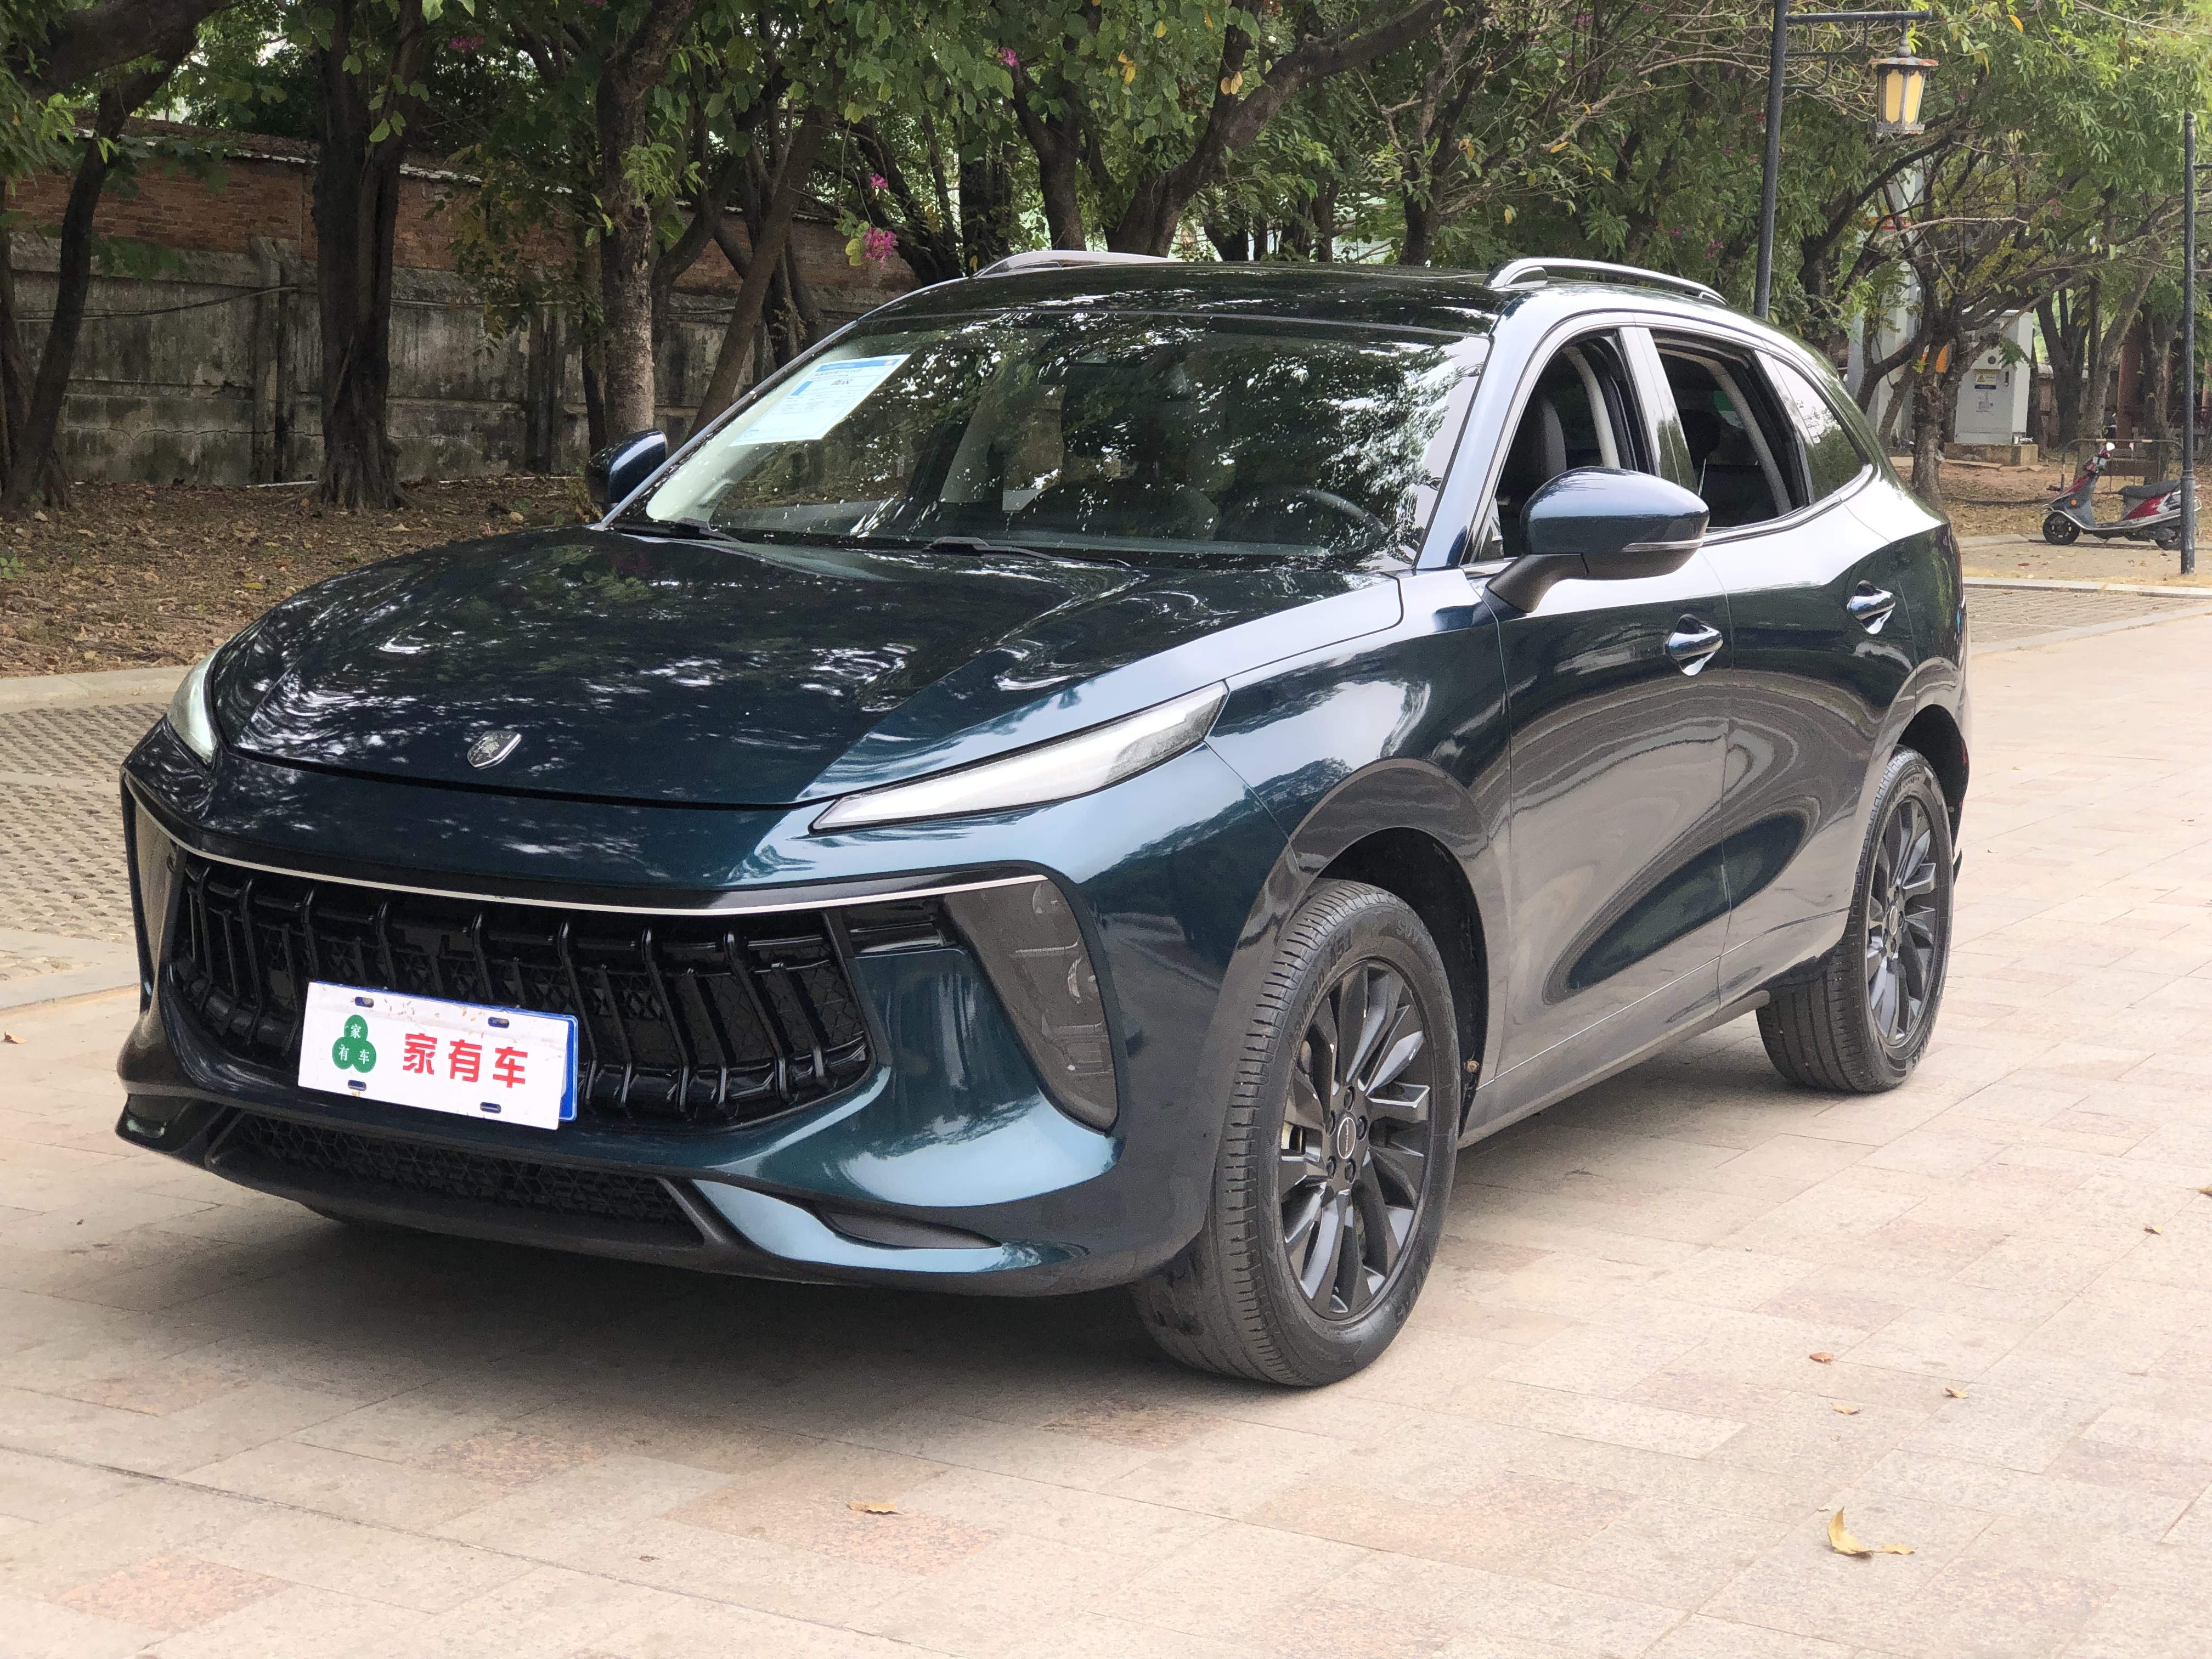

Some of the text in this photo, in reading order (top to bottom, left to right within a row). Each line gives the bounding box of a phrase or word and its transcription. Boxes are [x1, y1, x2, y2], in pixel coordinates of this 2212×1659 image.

[1330, 928, 1352, 971] A51
[350, 1023, 362, 1039] 家
[402, 1032, 529, 1088] 家有车
